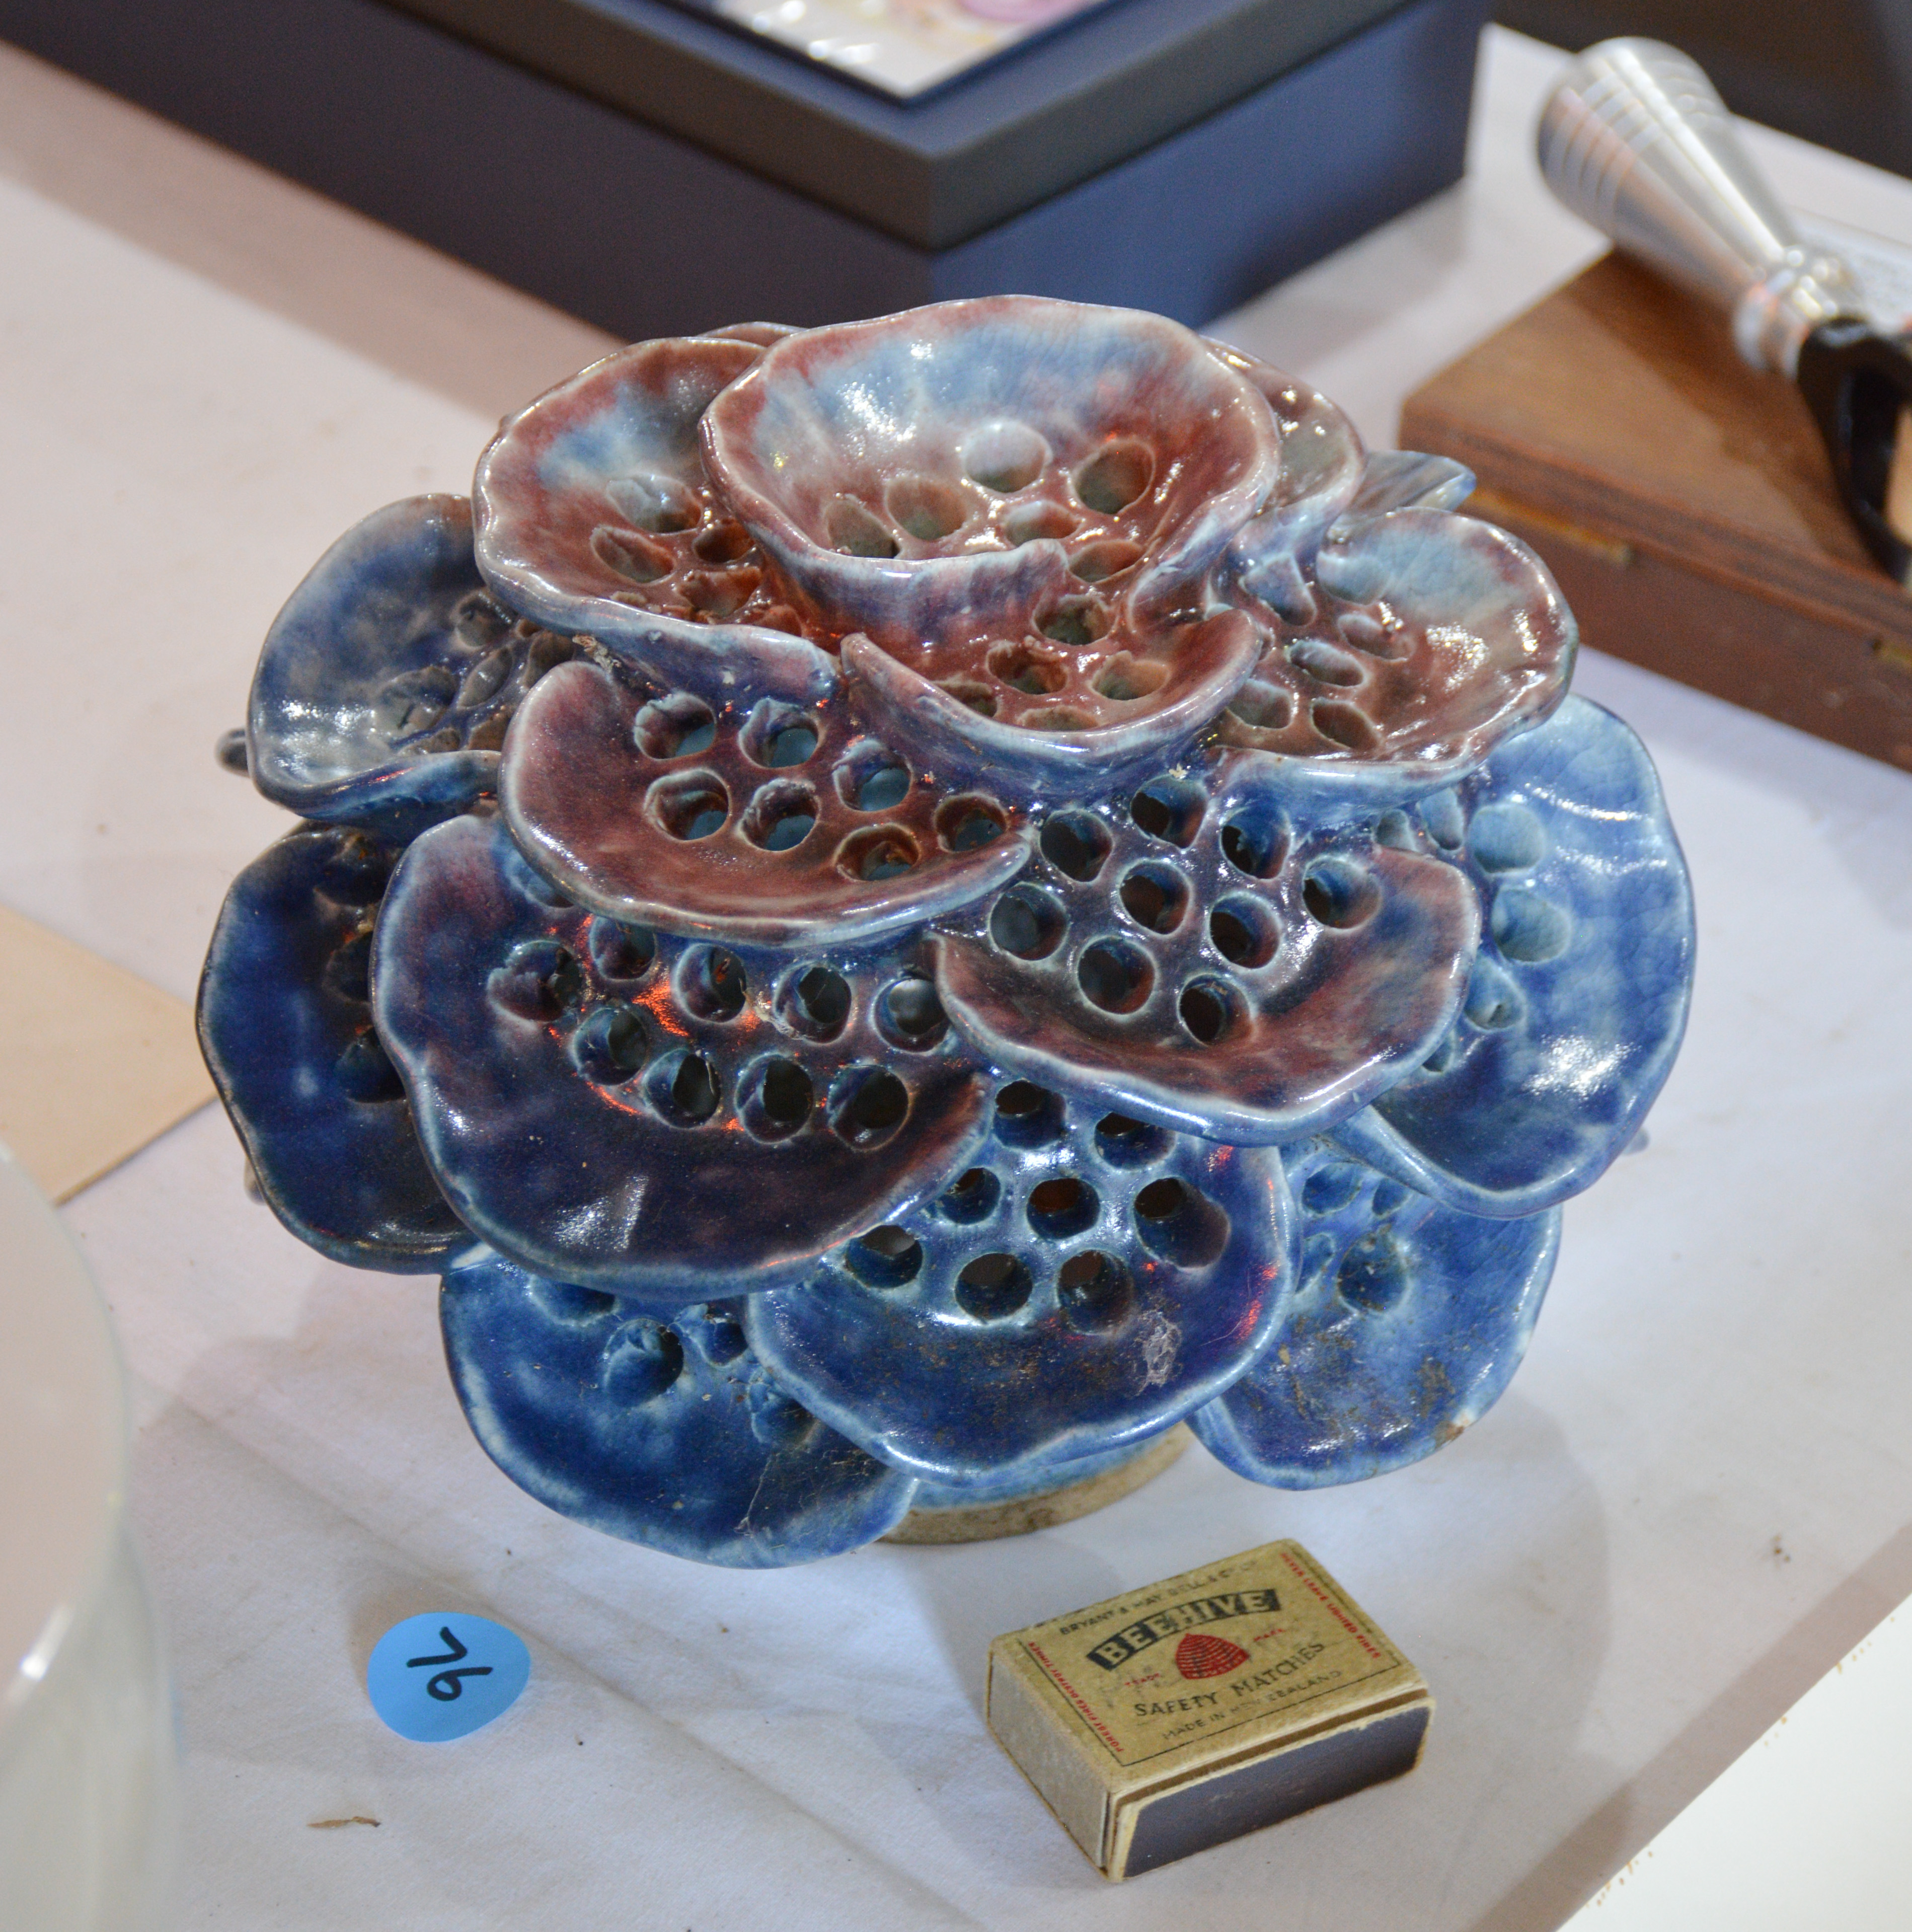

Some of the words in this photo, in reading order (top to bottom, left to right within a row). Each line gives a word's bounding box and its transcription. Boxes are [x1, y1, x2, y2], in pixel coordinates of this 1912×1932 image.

[1060, 1610, 1114, 1635] BRYANT
[1093, 1590, 1269, 1666] BEEHIVE
[1303, 1578, 1329, 1601] LEAVE
[1327, 1603, 1358, 1633] LIGHTED
[407, 1626, 493, 1701] 76
[1134, 1692, 1217, 1717] SAFETY
[1231, 1643, 1325, 1697] MATCHES
[1094, 1723, 1125, 1753] FOREST
[1163, 1719, 1205, 1740] MADE
[1210, 1712, 1226, 1722] IN
[1268, 1670, 1343, 1701] ZEALAND
